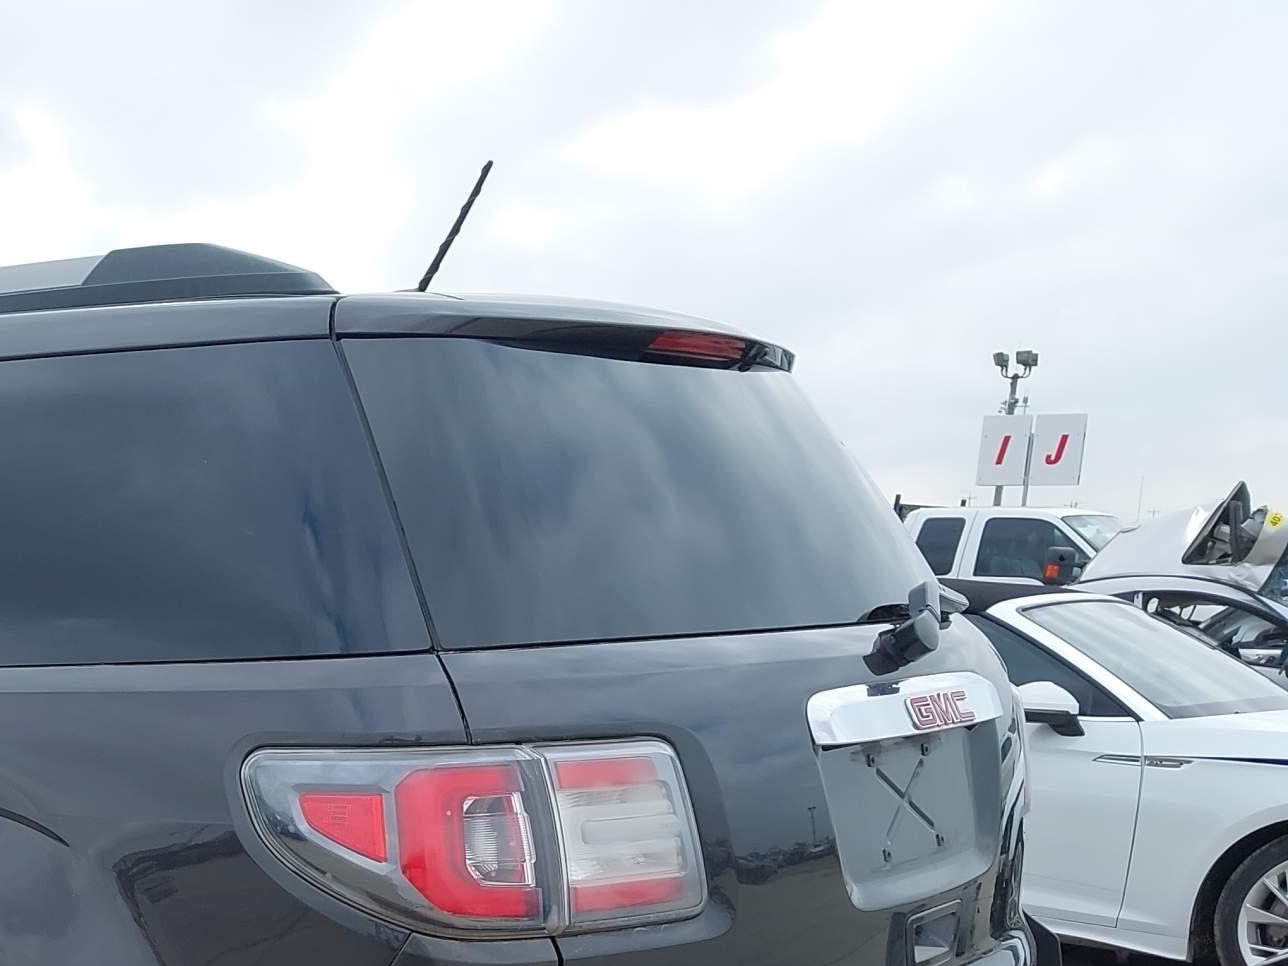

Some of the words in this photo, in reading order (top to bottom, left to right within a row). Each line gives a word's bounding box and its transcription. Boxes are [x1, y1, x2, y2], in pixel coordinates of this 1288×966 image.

[995, 435, 1012, 465] I
[1045, 434, 1070, 465] J
[904, 689, 977, 730] GMC
